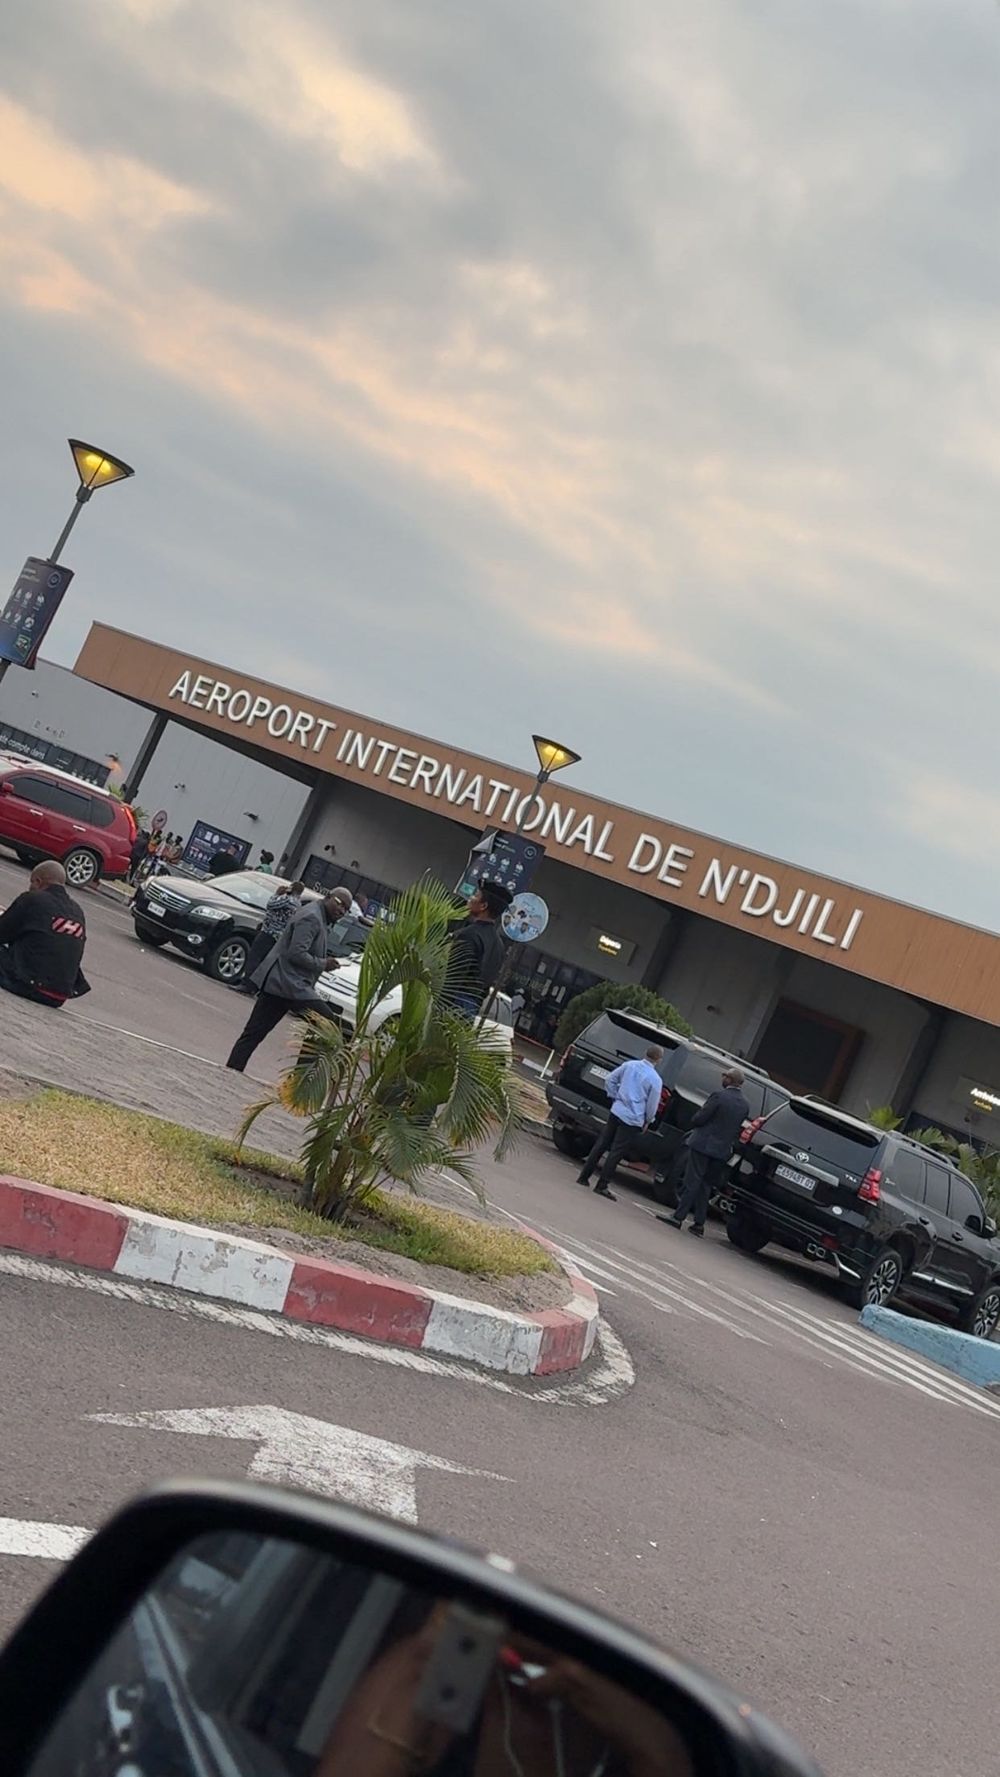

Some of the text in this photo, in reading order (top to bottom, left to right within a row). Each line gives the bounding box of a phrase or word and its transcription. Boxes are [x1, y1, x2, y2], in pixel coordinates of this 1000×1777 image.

[168, 669, 864, 950] AEROPORT INTERNATIONAL DE N'DJILI
